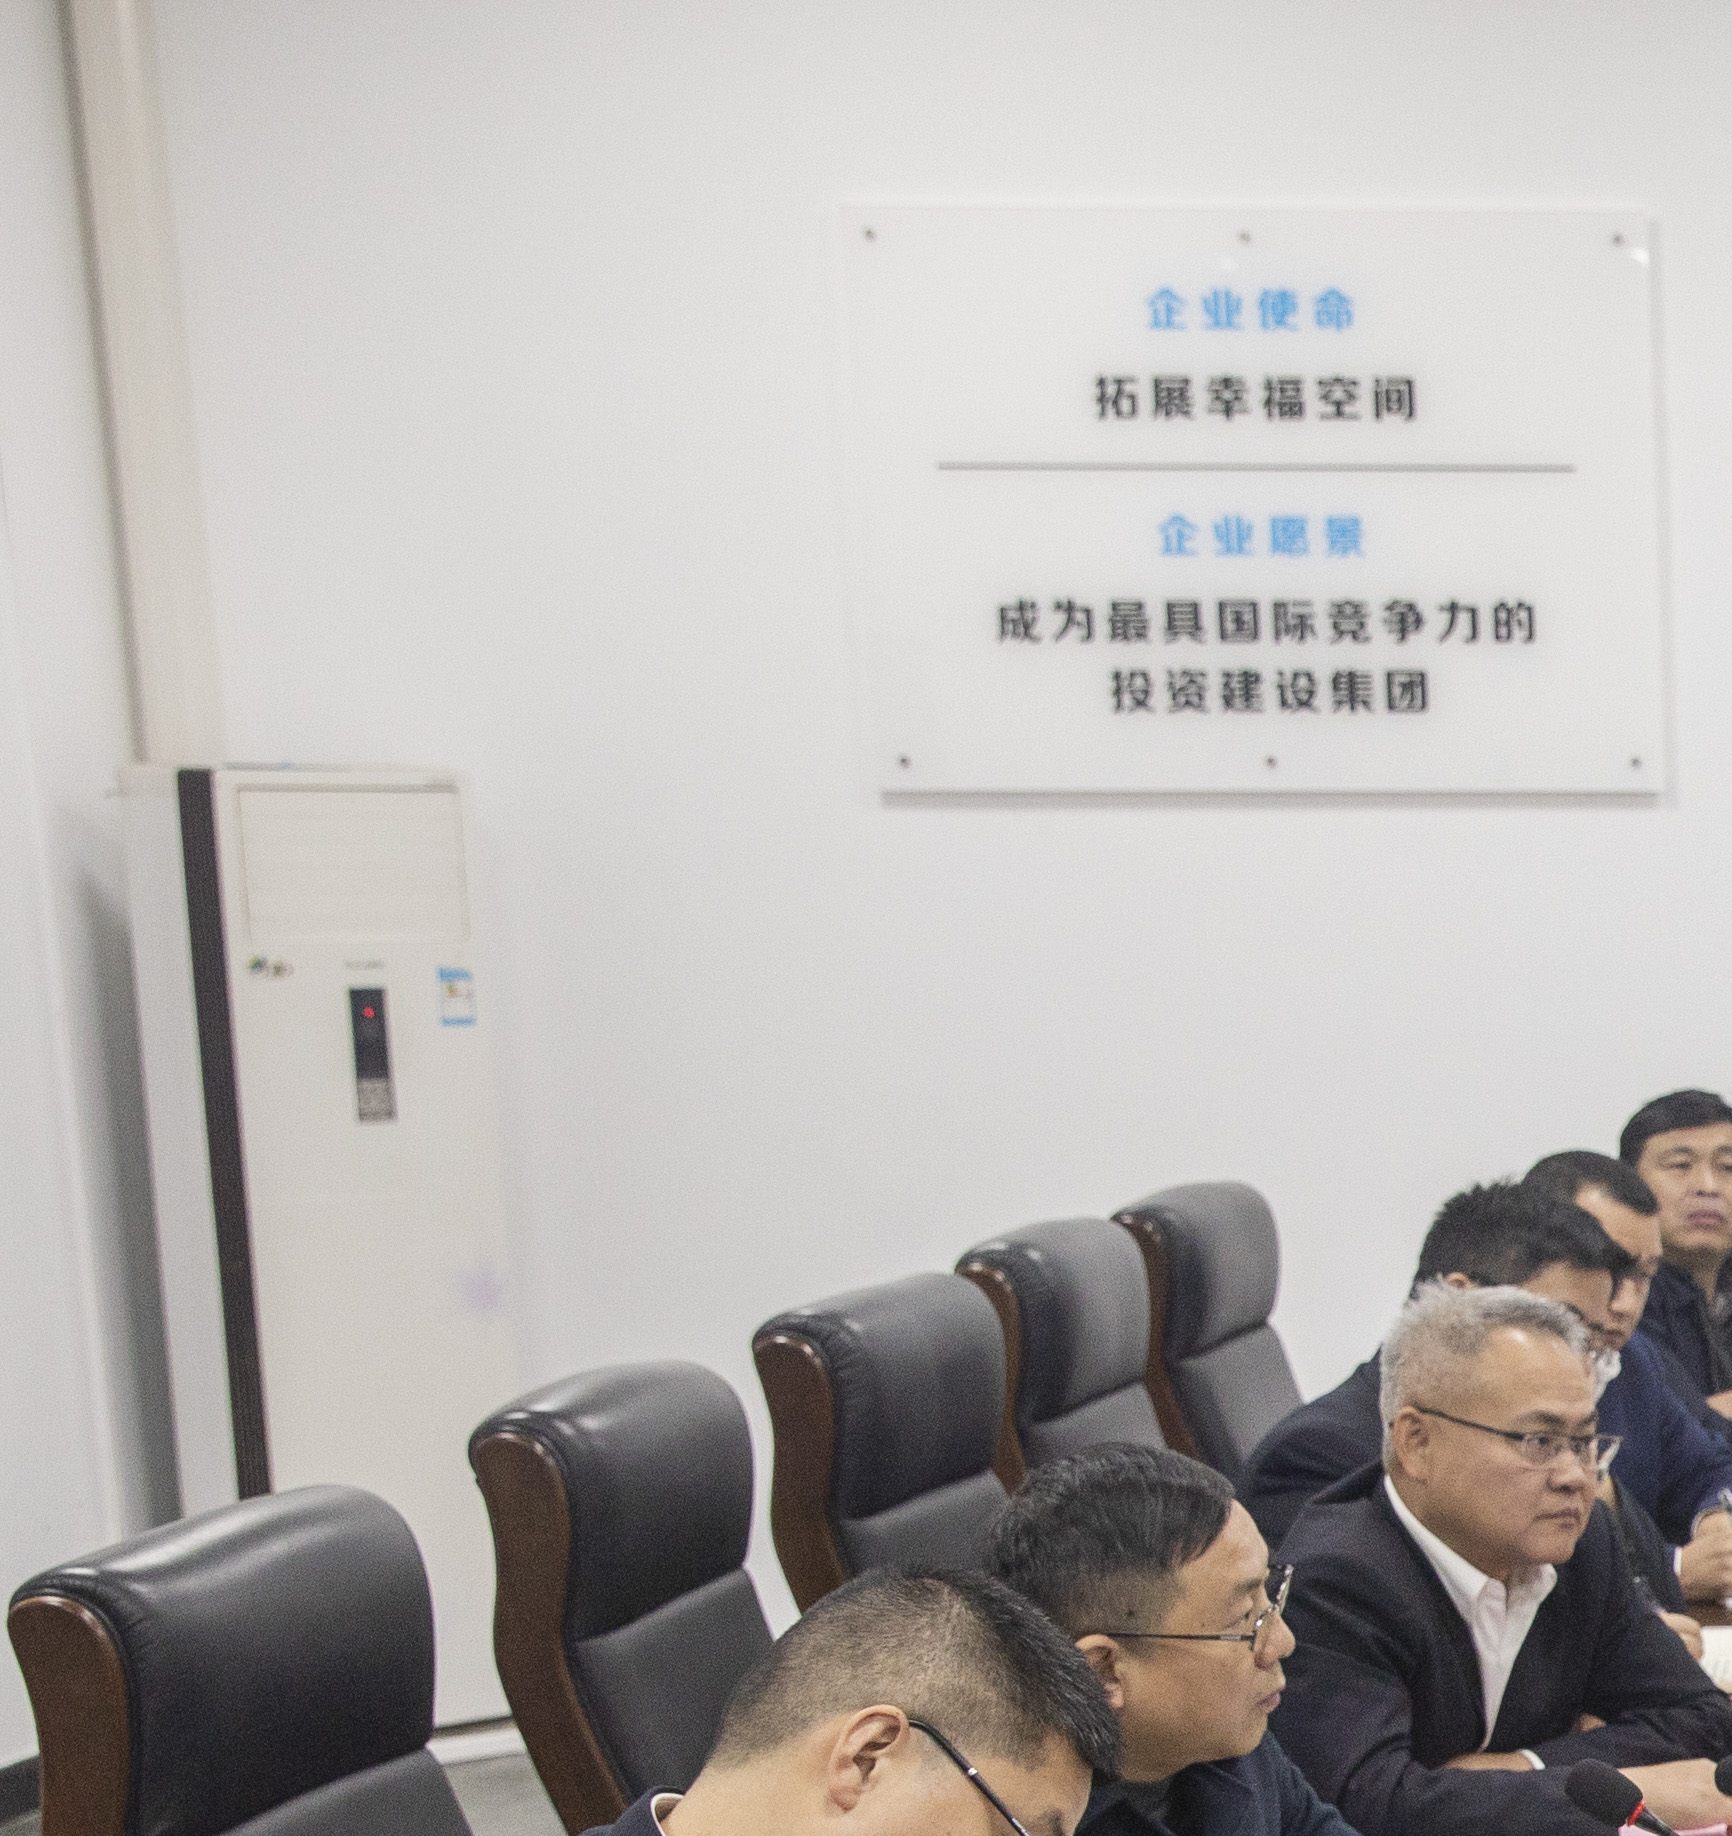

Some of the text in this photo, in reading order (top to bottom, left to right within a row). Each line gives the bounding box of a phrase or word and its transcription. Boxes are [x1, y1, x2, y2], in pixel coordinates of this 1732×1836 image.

[1147, 286, 1356, 332] 企业使命
[1094, 374, 1419, 423] 拓展幸福空间
[1158, 513, 1365, 558] 企业愿景
[997, 597, 1538, 645] 成为最具国际竞争力的
[1110, 667, 1430, 714] 投资建设集团
